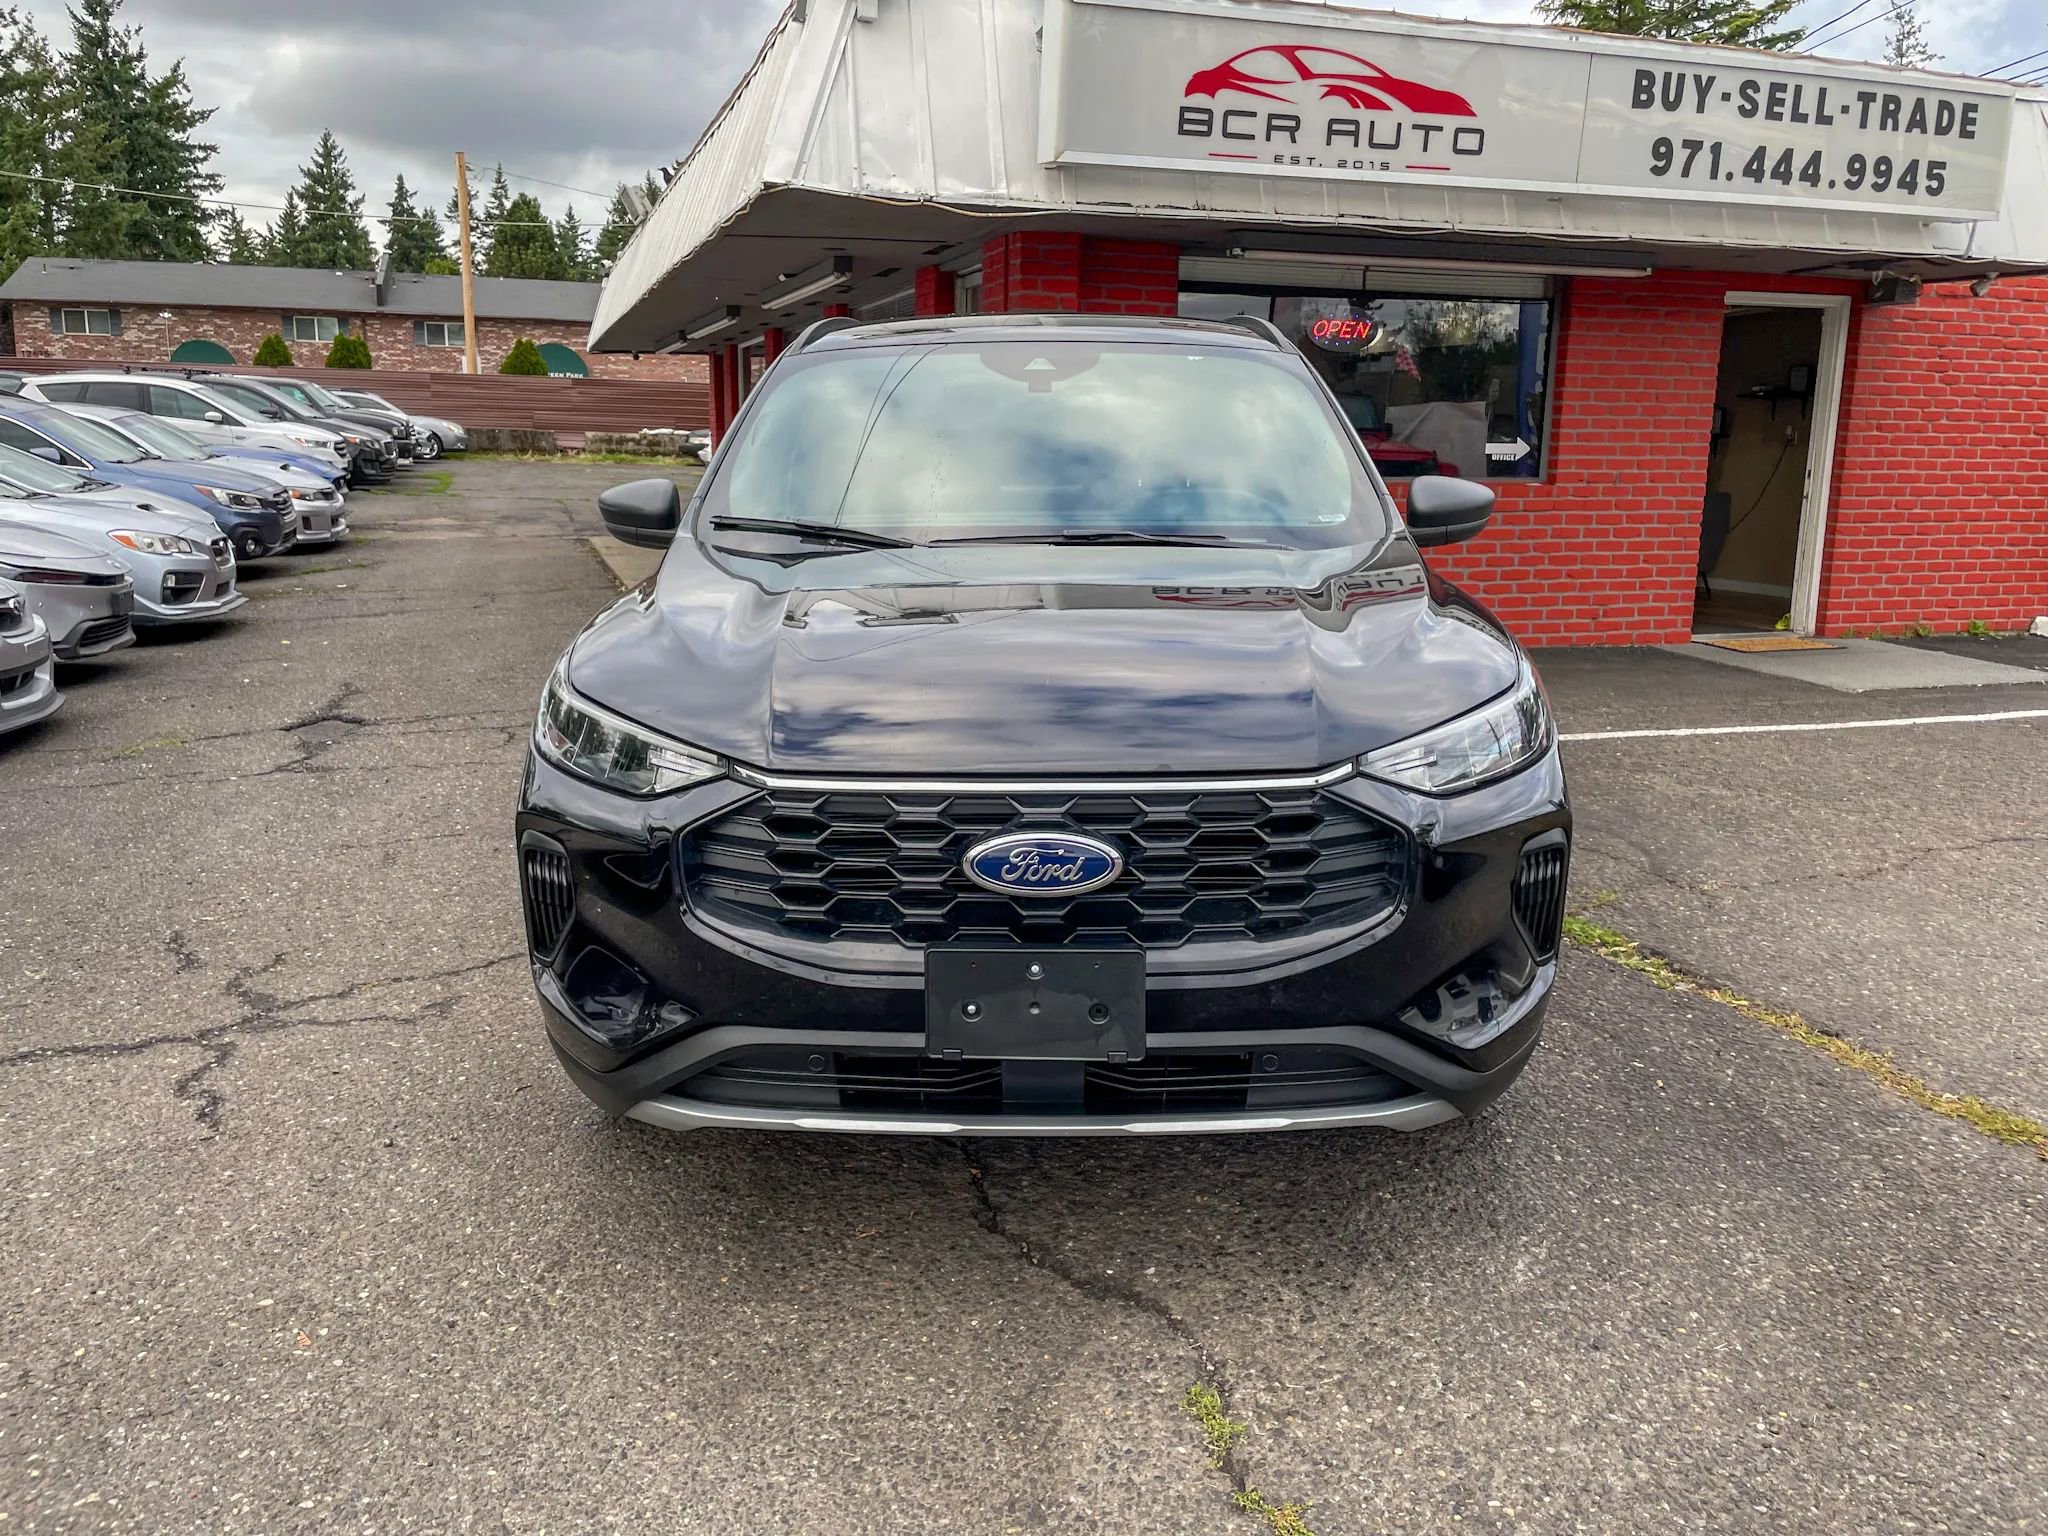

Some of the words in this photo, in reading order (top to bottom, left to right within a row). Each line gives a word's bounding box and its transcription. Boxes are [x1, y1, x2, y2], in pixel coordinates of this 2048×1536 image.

[1177, 106, 1301, 144] BCR
[1325, 117, 1485, 155] AUTO
[1273, 154, 1323, 168] EST.
[1337, 159, 1390, 171] 2015
[1649, 137, 1948, 197] 971.444.9945
[1312, 319, 1372, 339] OPEN
[1001, 847, 1086, 882] Ford
